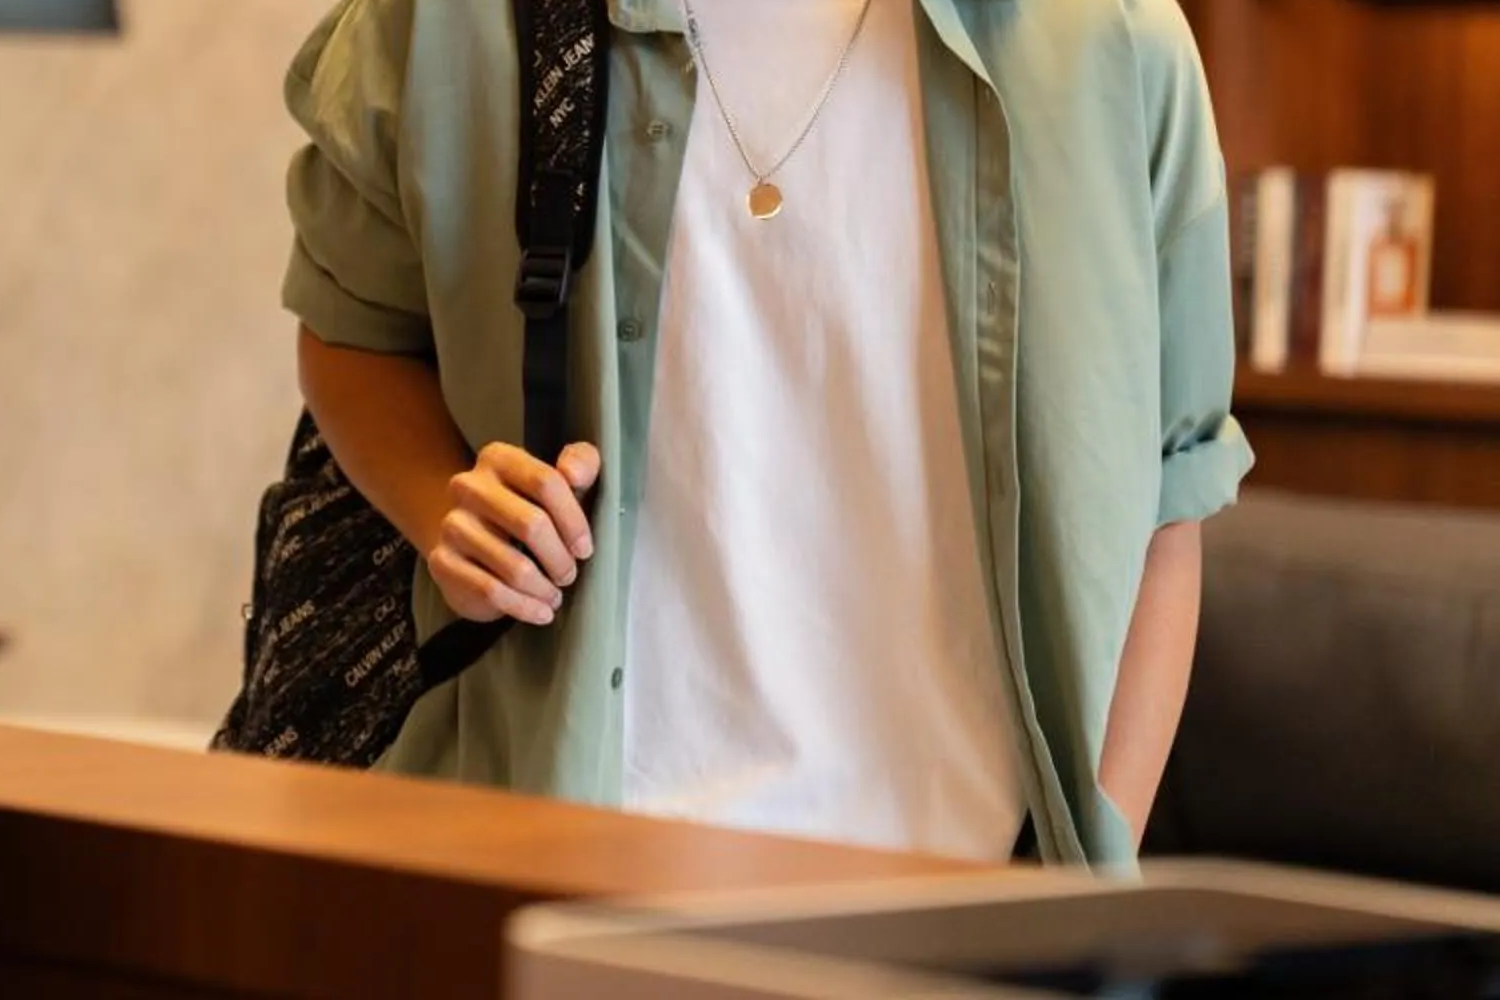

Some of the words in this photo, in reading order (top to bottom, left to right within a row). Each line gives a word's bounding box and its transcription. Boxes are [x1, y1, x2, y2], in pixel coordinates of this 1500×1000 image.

[533, 66, 564, 108] KLEIN
[550, 98, 576, 128] NYC
[344, 646, 382, 688] CALVIN
